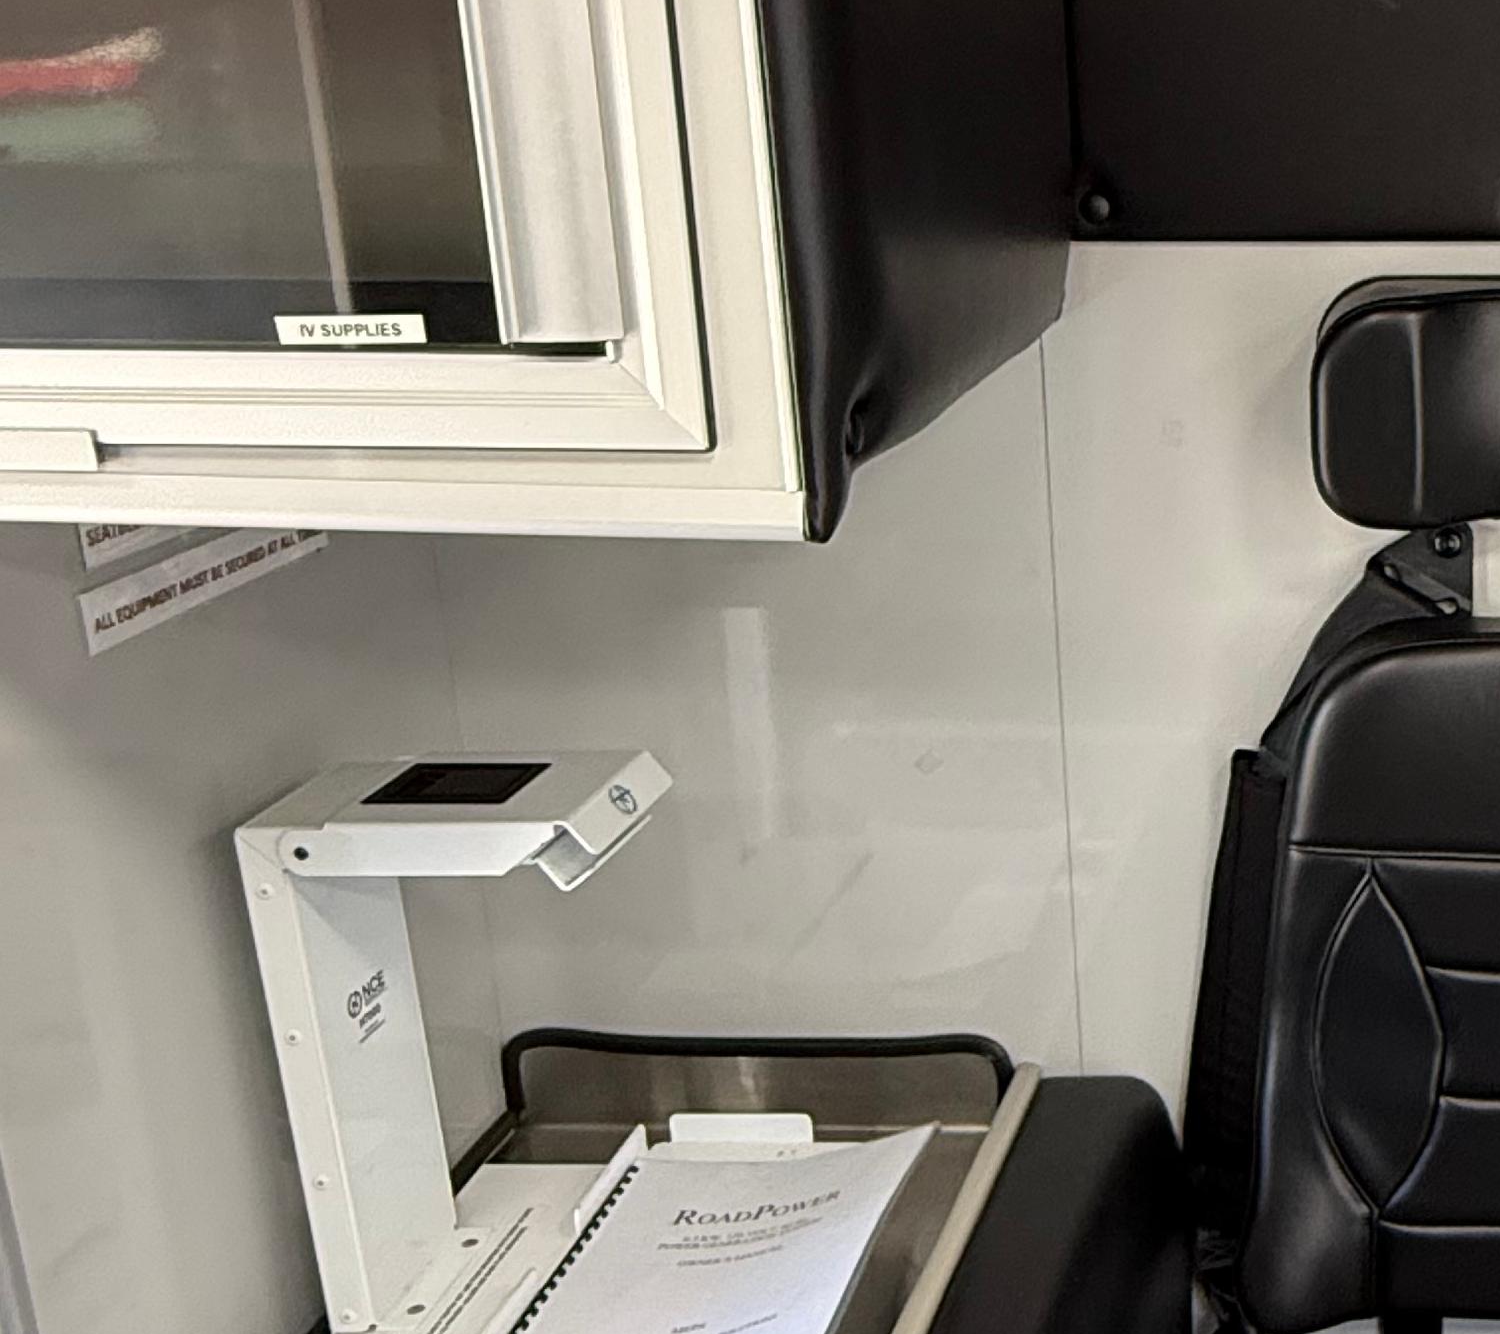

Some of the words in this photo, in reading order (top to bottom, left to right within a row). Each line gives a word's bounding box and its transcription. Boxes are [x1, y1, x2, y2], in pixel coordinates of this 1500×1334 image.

[299, 324, 315, 337] IV
[320, 323, 403, 337] SUPPLIES
[95, 613, 116, 634] ALL
[117, 583, 178, 624] EQUIPMENT
[179, 572, 210, 595] MUST
[211, 564, 225, 581] BE
[225, 545, 267, 574] SECURED
